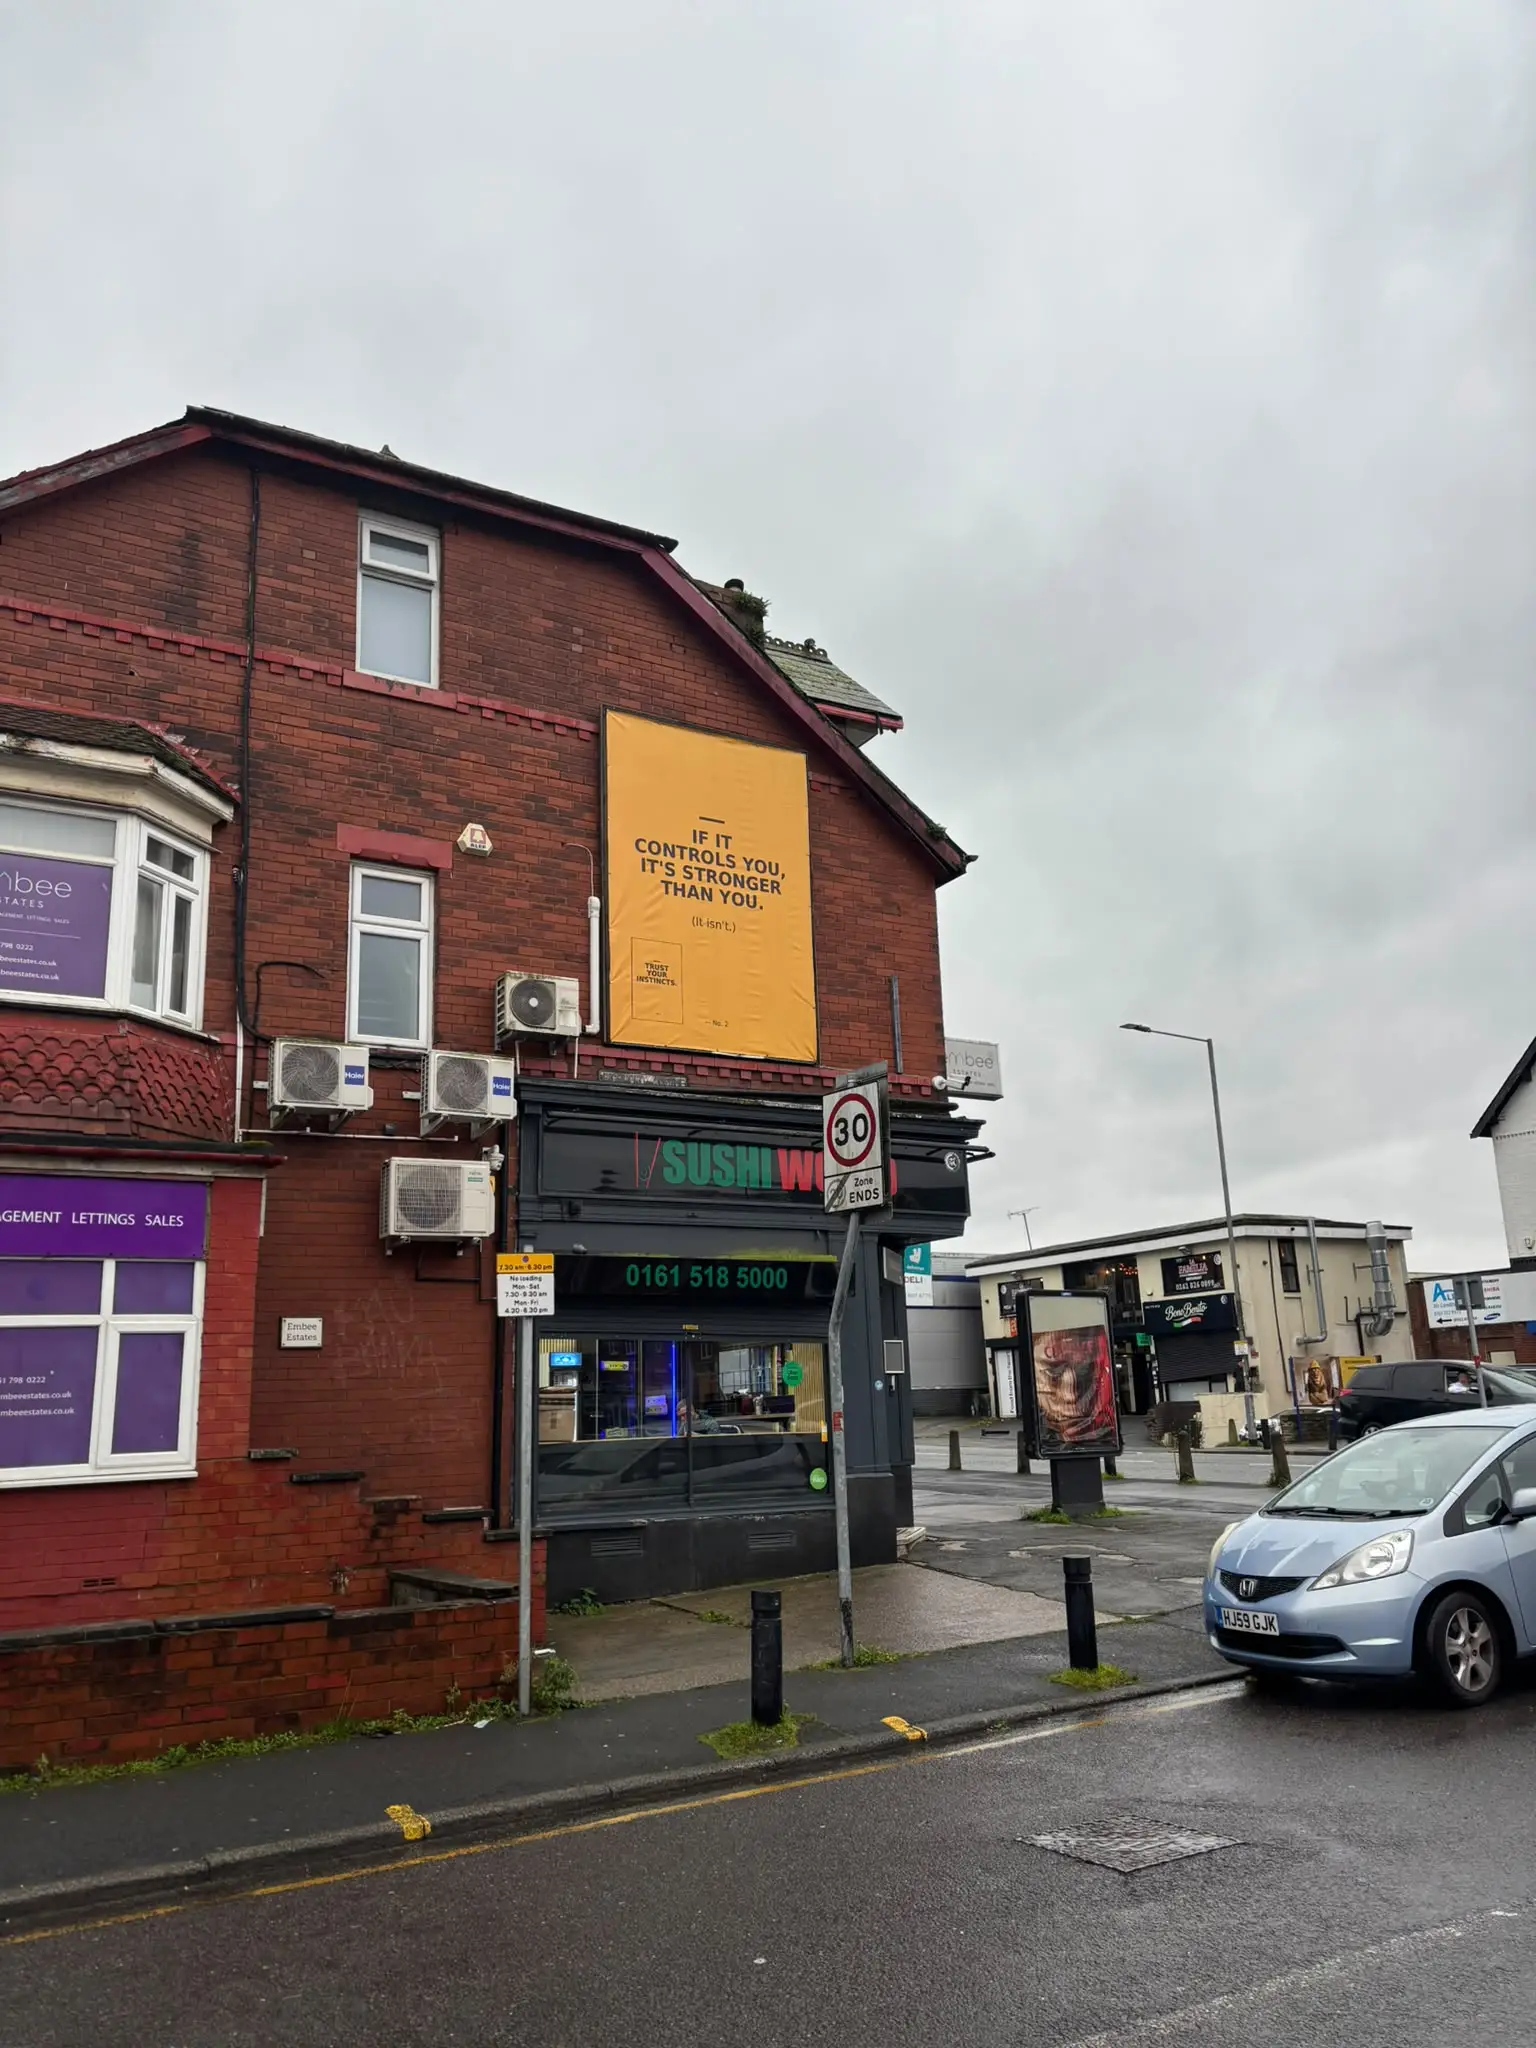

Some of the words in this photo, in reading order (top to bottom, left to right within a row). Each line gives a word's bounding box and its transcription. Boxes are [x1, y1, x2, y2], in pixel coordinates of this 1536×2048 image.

[692, 829, 708, 845] IF
[715, 833, 732, 850] IT
[634, 838, 736, 869] CONTROLS
[742, 856, 786, 880] YOU,
[641, 857, 676, 877] IT'S
[682, 864, 782, 895] STRONGER
[660, 879, 713, 902] THAN
[719, 888, 764, 910] YOU.
[691, 915, 703, 927] (It
[706, 917, 736, 934] isn't.)
[645, 962, 670, 972] TRUST
[646, 970, 668, 978] YOUR
[636, 976, 678, 987] INSTINCTS.
[344, 1071, 365, 1080] Haier
[492, 1081, 511, 1090] Haier
[834, 1112, 869, 1147] 30
[663, 1140, 771, 1188] SUSHI
[854, 1177, 874, 1188] Zone
[849, 1187, 881, 1204] ENDS
[0, 1210, 62, 1224] GEMENT
[71, 1212, 136, 1226] LETTINGS
[144, 1214, 184, 1227] SALES
[625, 1263, 680, 1288] 0161
[689, 1265, 730, 1289] 518
[736, 1266, 788, 1290] 5000
[1223, 1610, 1251, 1629] HJ59
[1252, 1614, 1277, 1633] GJK
